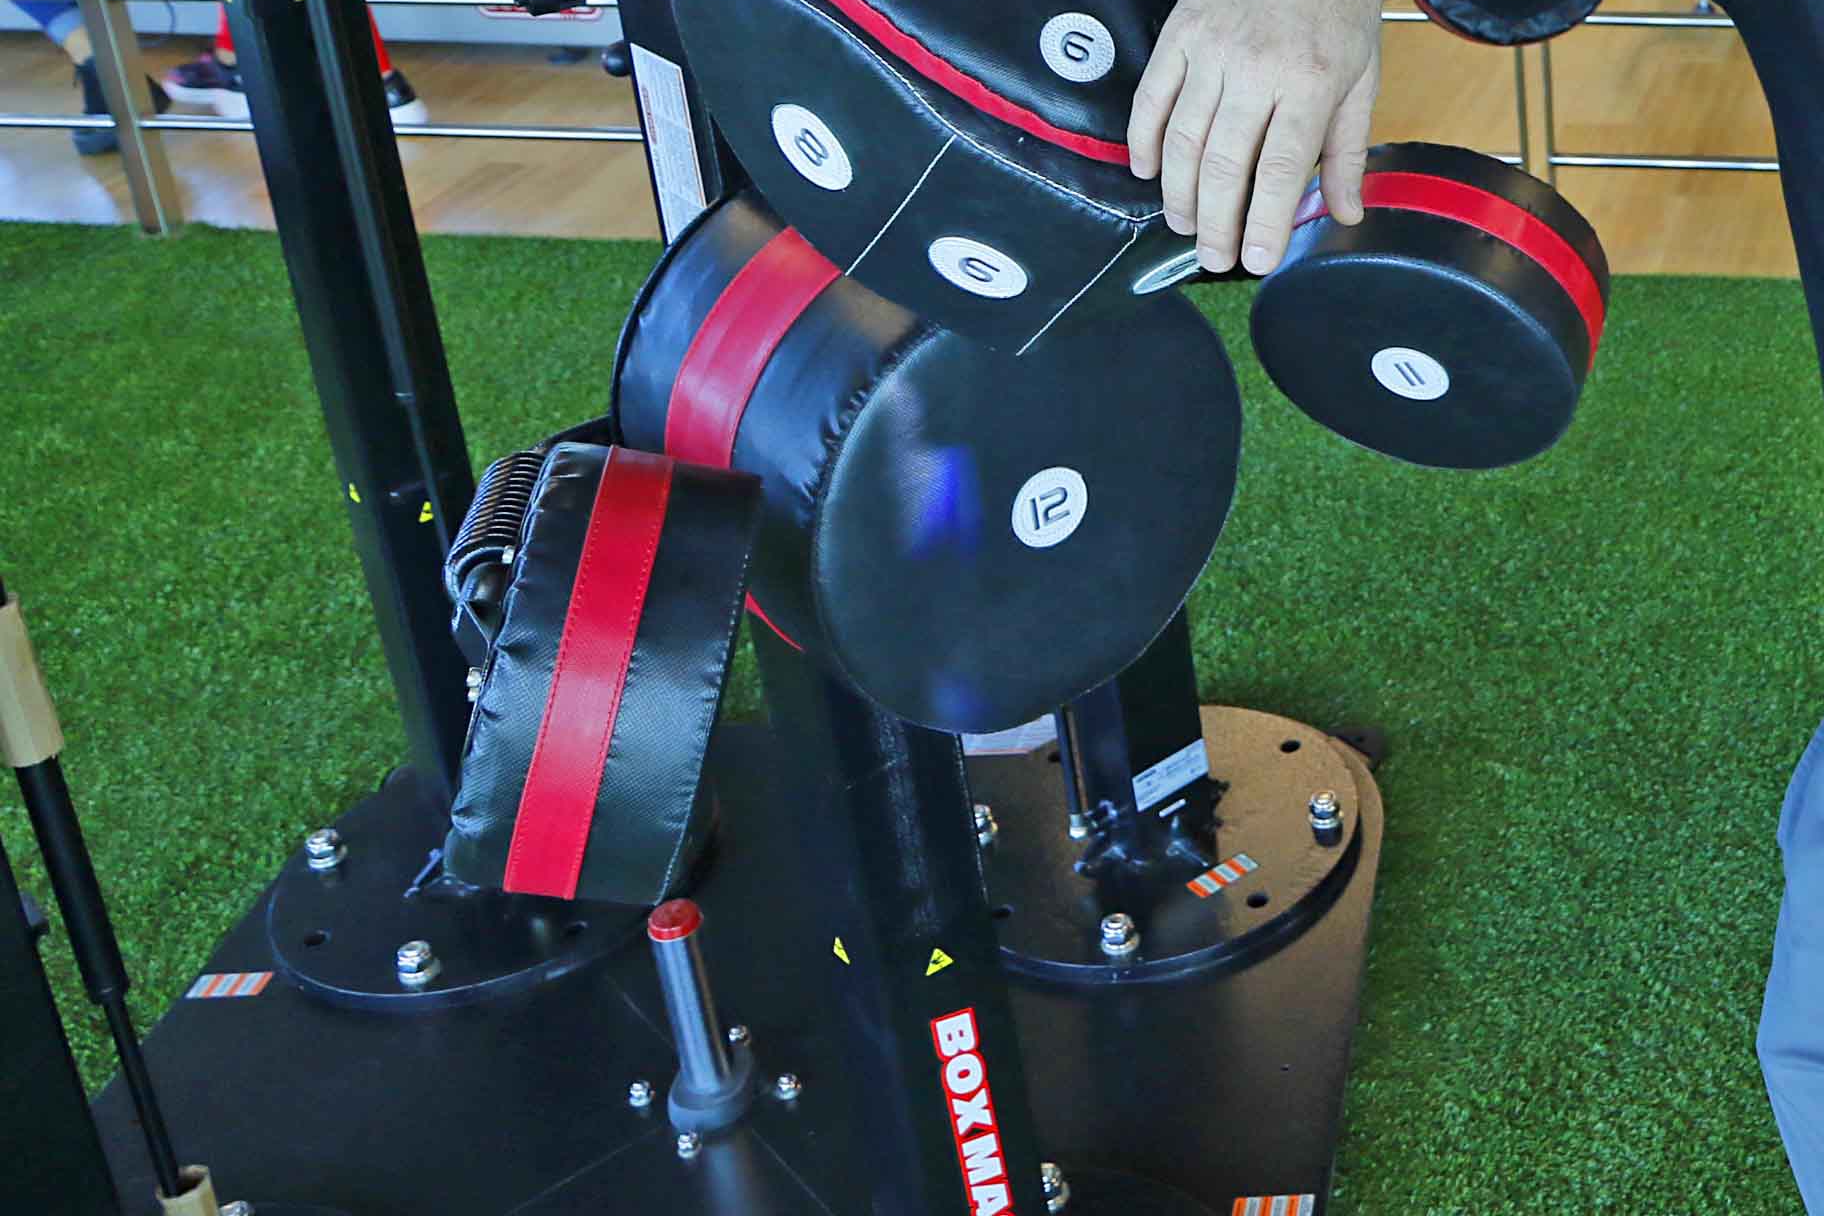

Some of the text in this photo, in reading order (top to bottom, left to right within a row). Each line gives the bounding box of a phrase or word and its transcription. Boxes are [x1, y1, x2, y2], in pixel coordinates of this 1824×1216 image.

[1061, 31, 1095, 62] 6
[794, 128, 829, 167] 8
[1394, 361, 1426, 387] 11
[1030, 486, 1071, 531] 12
[932, 1010, 1012, 1216] BOXMA
